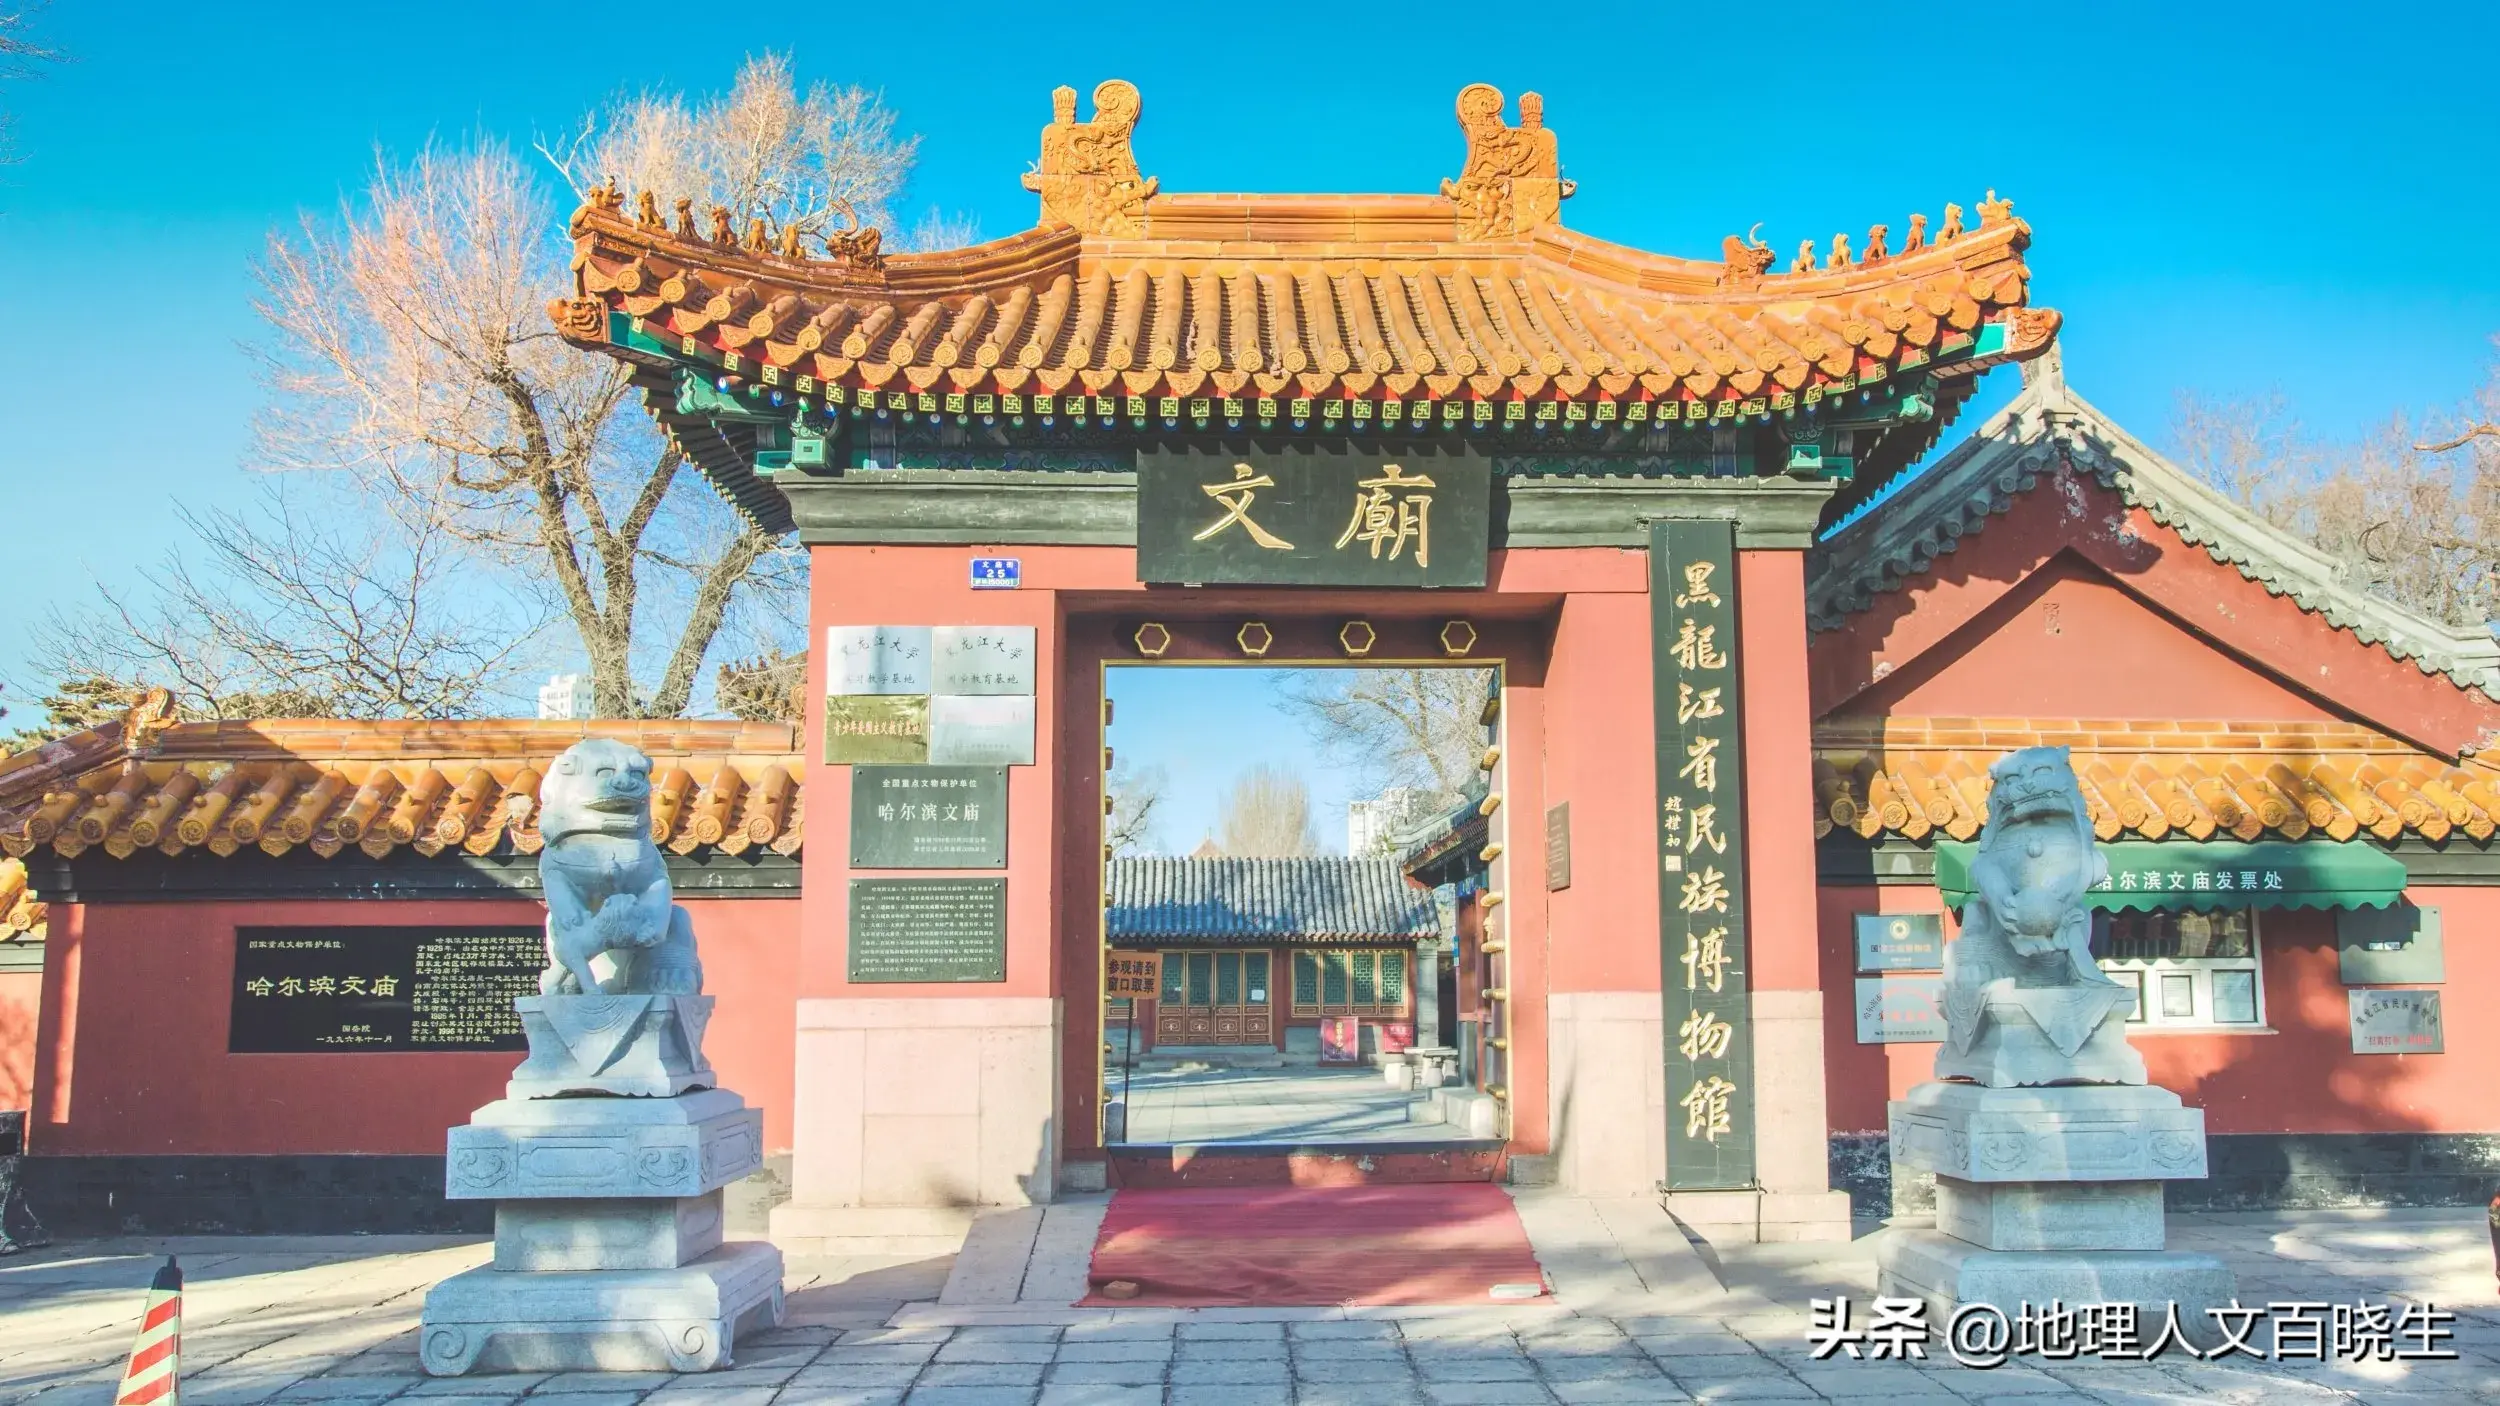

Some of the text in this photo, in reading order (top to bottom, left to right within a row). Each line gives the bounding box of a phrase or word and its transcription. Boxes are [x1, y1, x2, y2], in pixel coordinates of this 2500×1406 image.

[1192, 463, 1434, 568] 文廟
[986, 569, 1006, 578] 25
[882, 779, 977, 788] 全国重点文物保护单位
[878, 803, 980, 821] 哈尔滨文庙
[1670, 561, 1736, 1142] 黑龍江省民族博物館
[1108, 959, 1156, 976] 参观请到
[246, 975, 399, 997] 哈尔滨文庙
[1108, 977, 1154, 993] 窗口取票
[342, 1024, 371, 1033] 国务院
[316, 1035, 393, 1043] 一九九六年十一月
